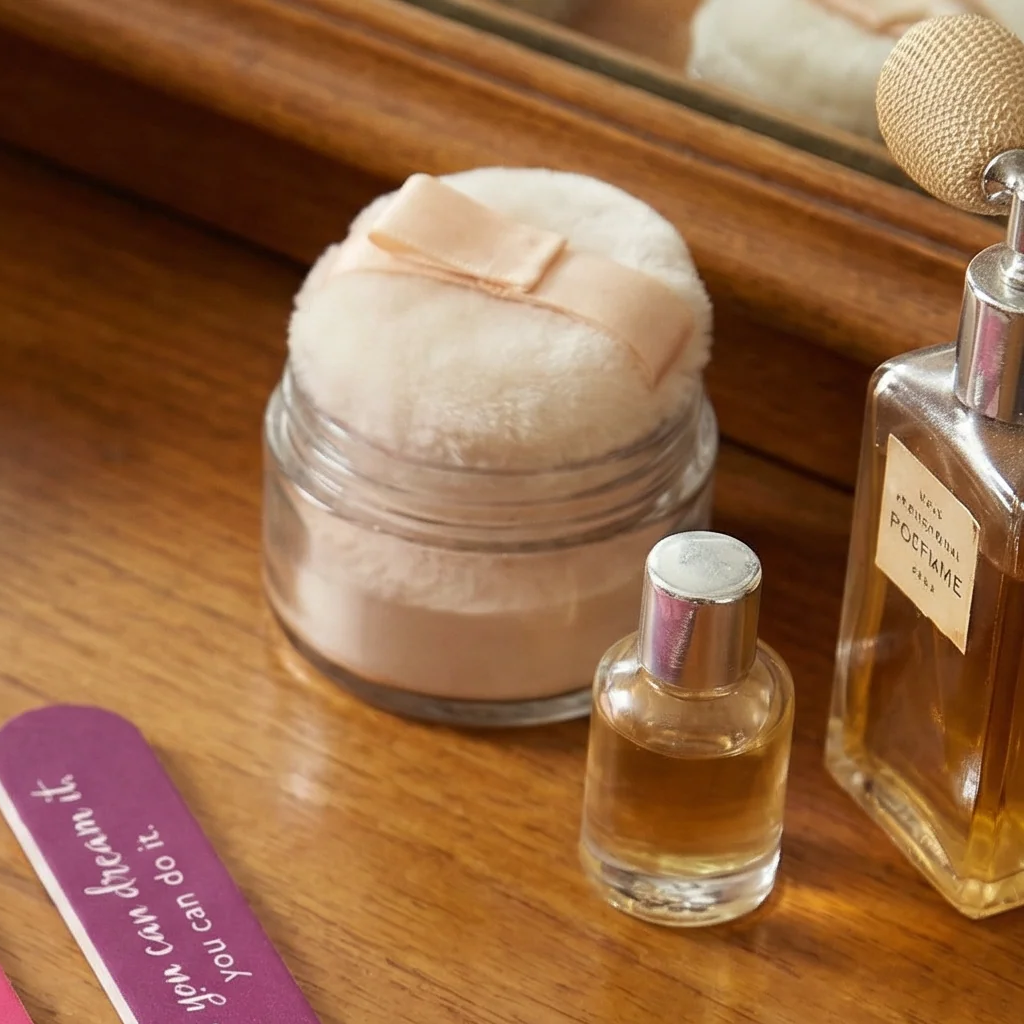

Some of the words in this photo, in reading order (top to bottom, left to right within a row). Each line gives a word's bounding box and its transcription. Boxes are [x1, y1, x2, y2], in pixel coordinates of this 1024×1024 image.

[72, 807, 139, 898] dream
[137, 824, 164, 852] it.
[154, 855, 184, 886] do
[128, 904, 173, 956] can
[176, 893, 212, 933] can
[203, 938, 253, 983] you
[164, 963, 227, 1012] you
